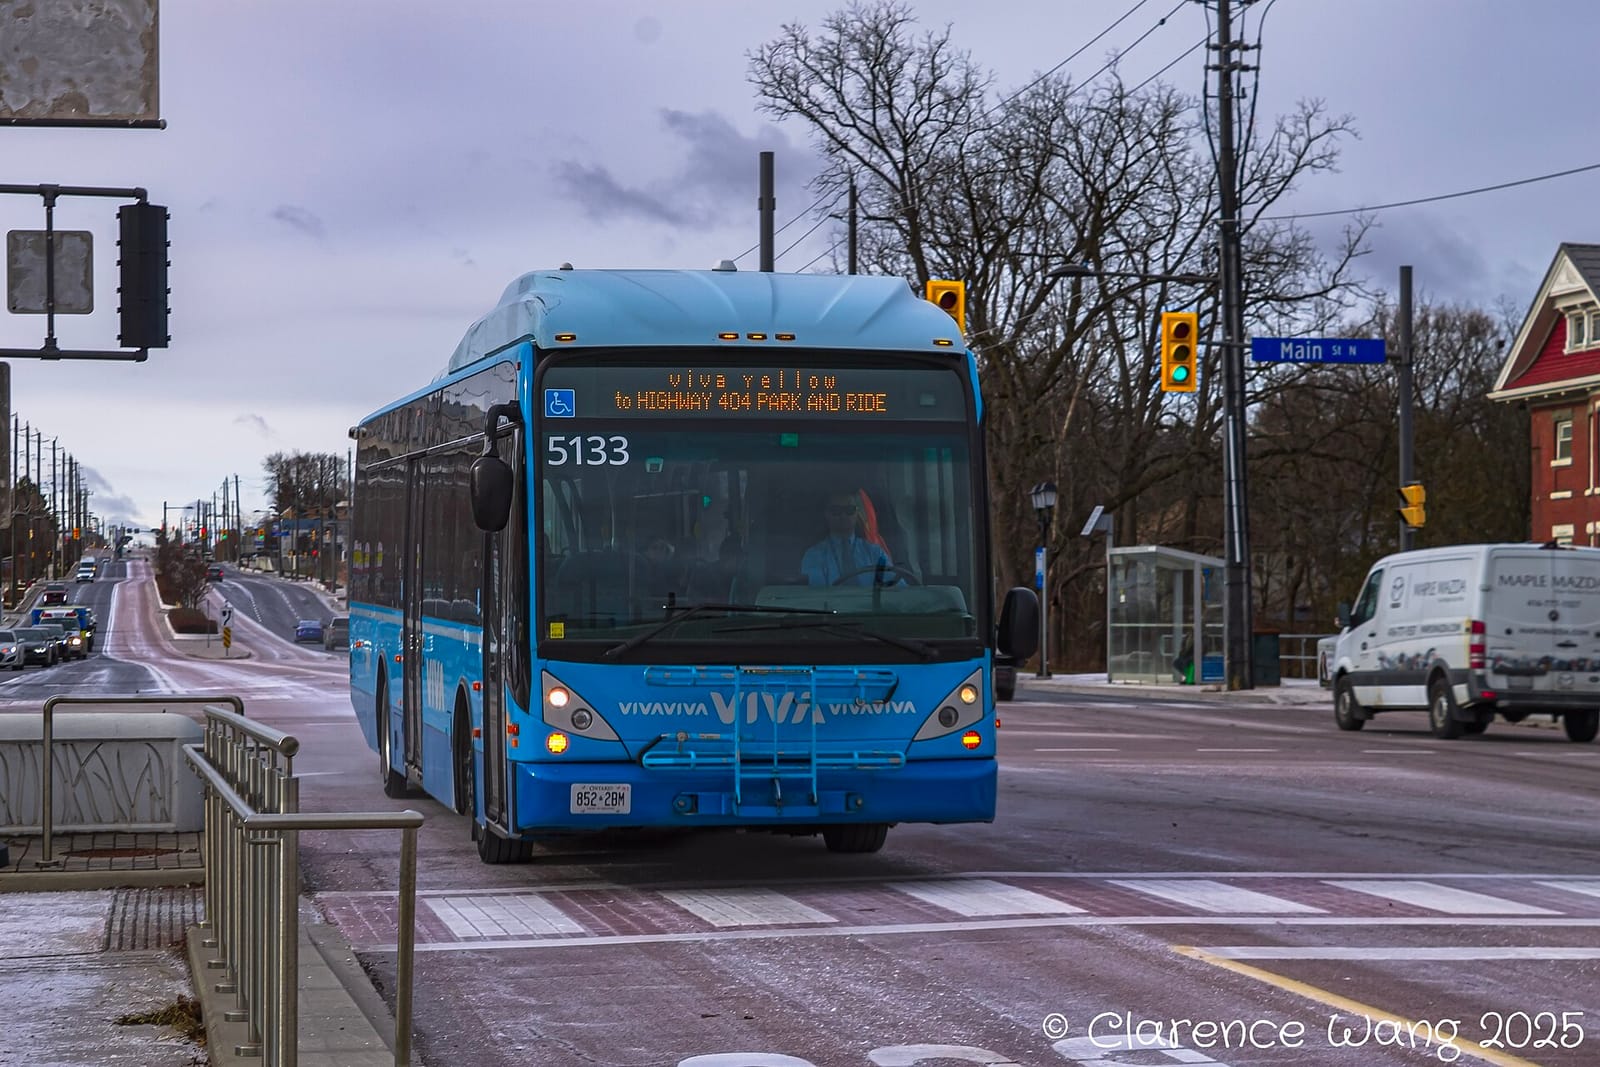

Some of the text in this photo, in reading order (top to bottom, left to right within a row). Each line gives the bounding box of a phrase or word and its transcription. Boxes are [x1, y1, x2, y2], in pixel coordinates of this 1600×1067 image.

[1280, 341, 1323, 360] Main
[1349, 345, 1357, 356] N
[669, 369, 836, 389] viva yellow
[615, 391, 887, 412] to HIGHWAY 404 PARK AND RIDE
[548, 435, 630, 466] 5133
[1499, 574, 1547, 589] MAPLE
[618, 702, 708, 716] VIVAVIVA
[710, 691, 826, 725] VIVA
